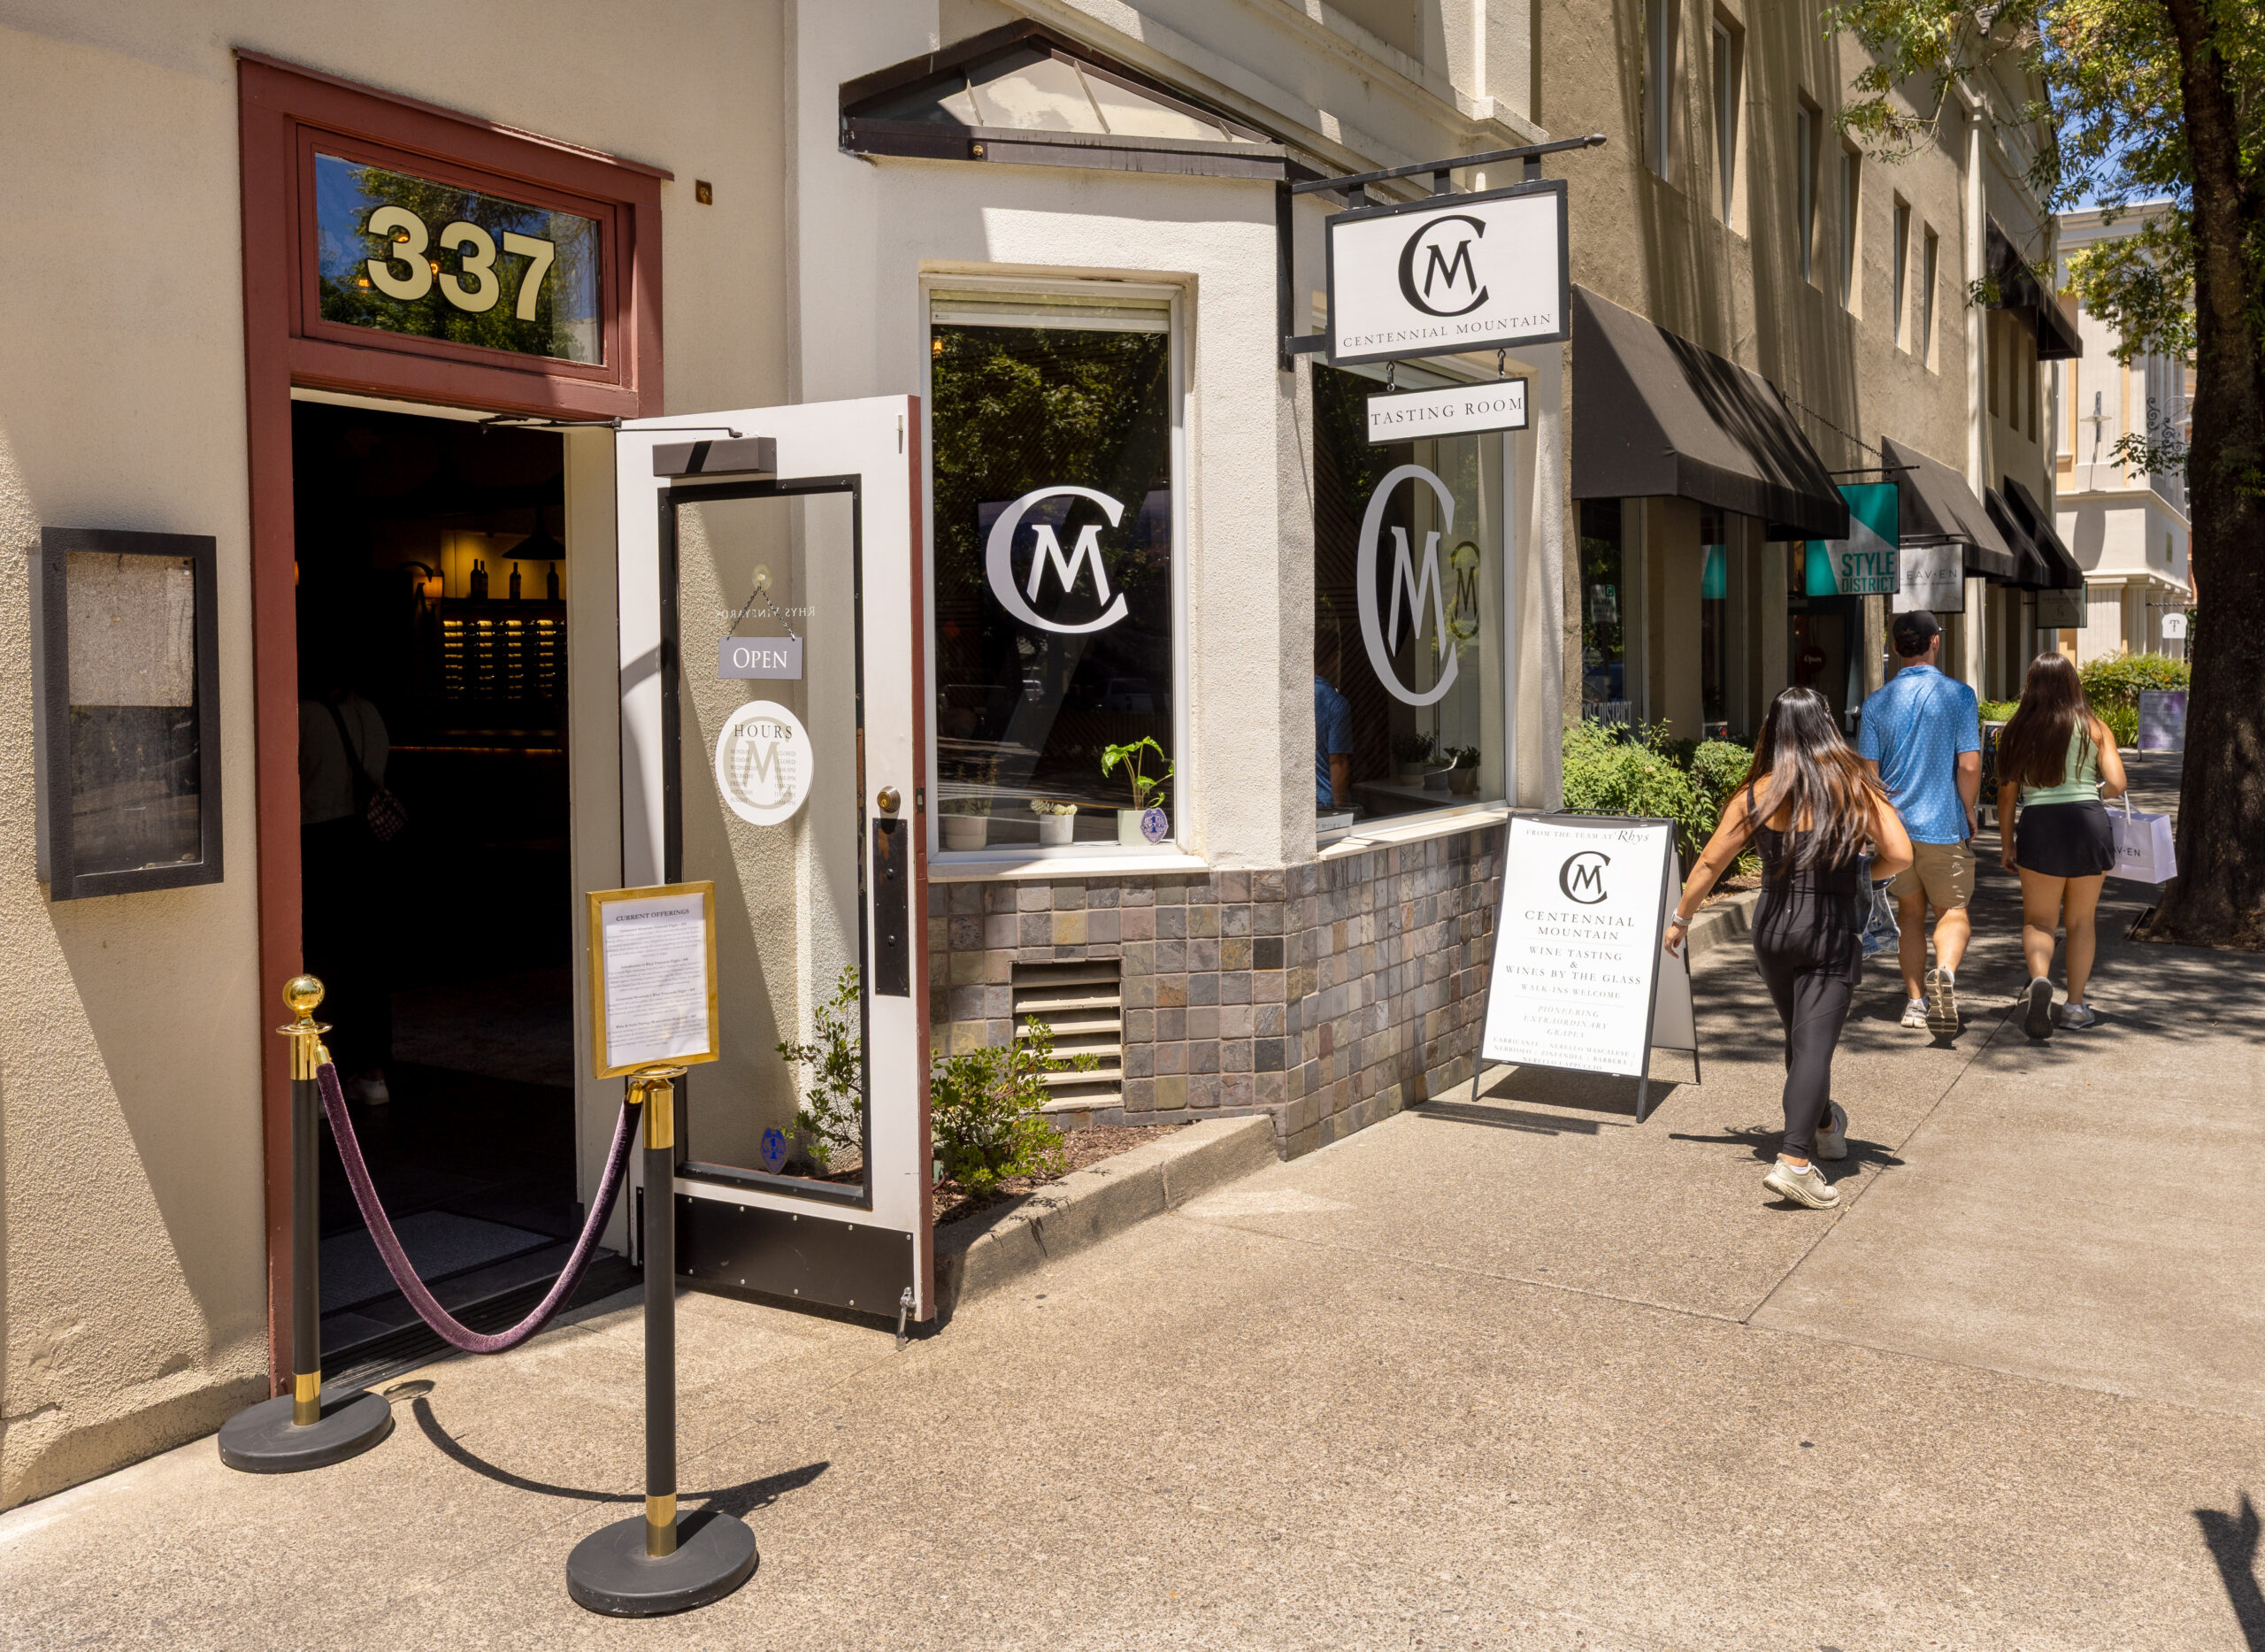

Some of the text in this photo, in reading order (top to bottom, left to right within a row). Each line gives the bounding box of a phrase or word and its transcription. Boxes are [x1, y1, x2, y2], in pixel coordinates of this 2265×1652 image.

[366, 204, 556, 322] 337
[1343, 313, 1551, 348] CENTENNIAL MOUNTAIN
[1371, 397, 1523, 426] TASTING ROOM
[1842, 551, 1895, 577] STYLE
[1900, 569, 1956, 580] EAV·EN
[1842, 577, 1895, 593] DISTRICT
[733, 647, 787, 669] OPEN
[734, 724, 793, 739] HOURS
[1615, 829, 1649, 845] Rhys
[616, 909, 690, 922] CURRENT OFFERINGS
[1524, 910, 1635, 927] CENTENNIAL
[1537, 926, 1619, 941] MOUNTAIN
[1529, 946, 1623, 961] WINE TASTING
[1506, 964, 1641, 985] WINES BY THE GLASS
[1572, 988, 1621, 999] WELCOME
[1537, 1004, 1600, 1018] PIONEERING
[1523, 1015, 1609, 1030] EXTRAORDINARY
